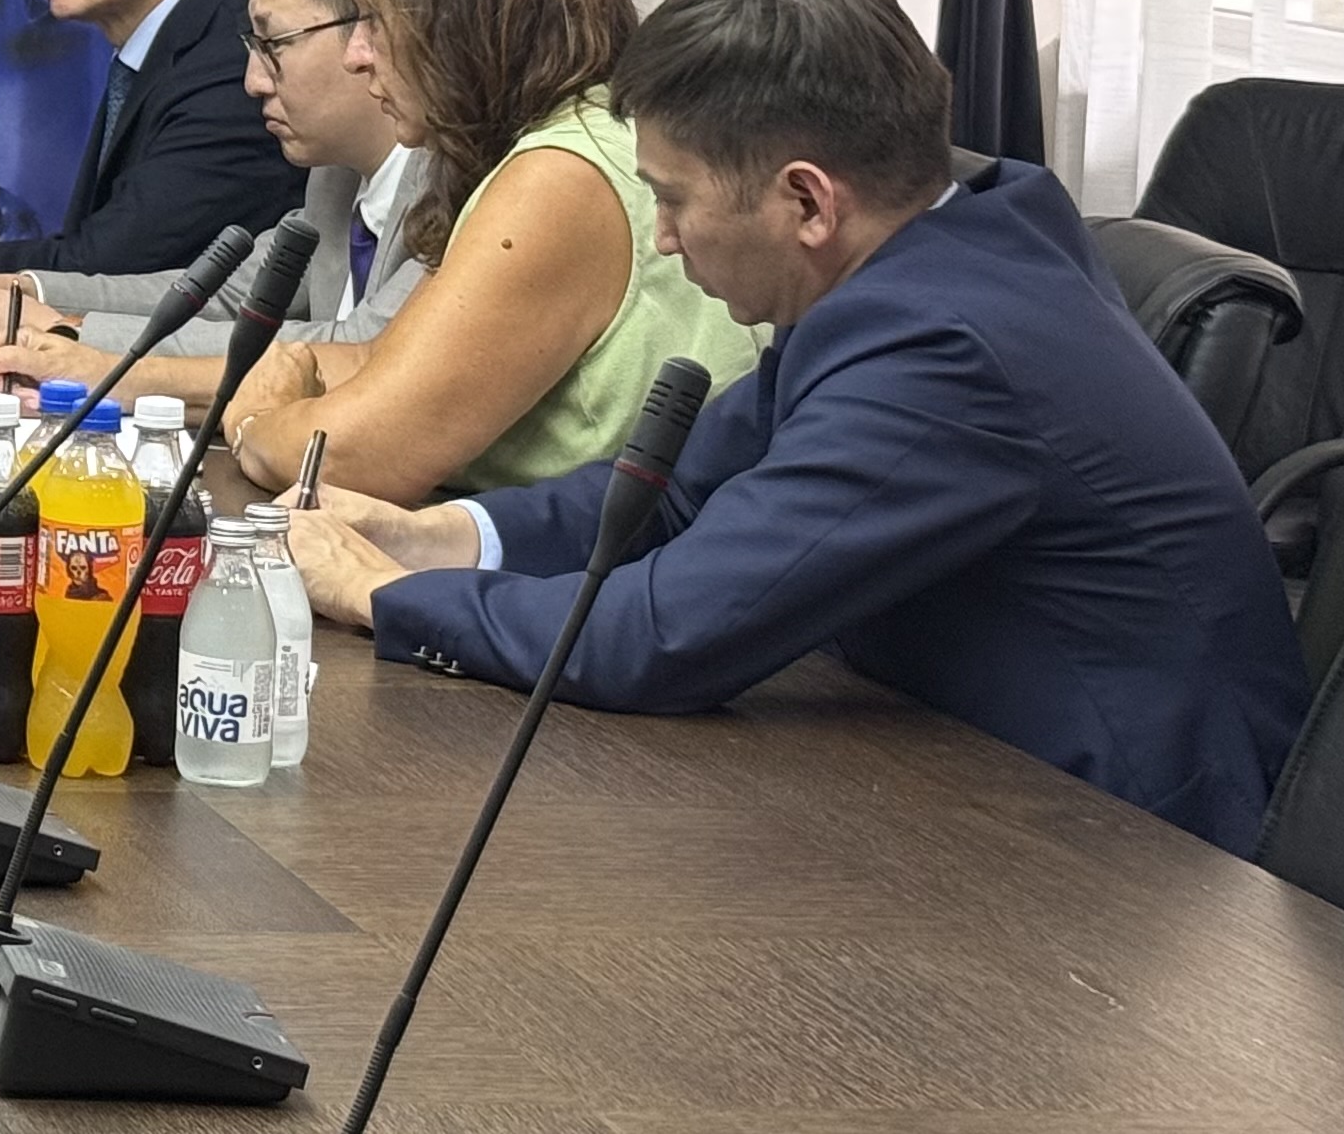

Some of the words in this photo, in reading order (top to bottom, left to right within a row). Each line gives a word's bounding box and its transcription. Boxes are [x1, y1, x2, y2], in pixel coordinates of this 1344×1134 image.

[55, 529, 119, 554] FANTA
[179, 684, 248, 718] aqua
[180, 709, 240, 743] viva
